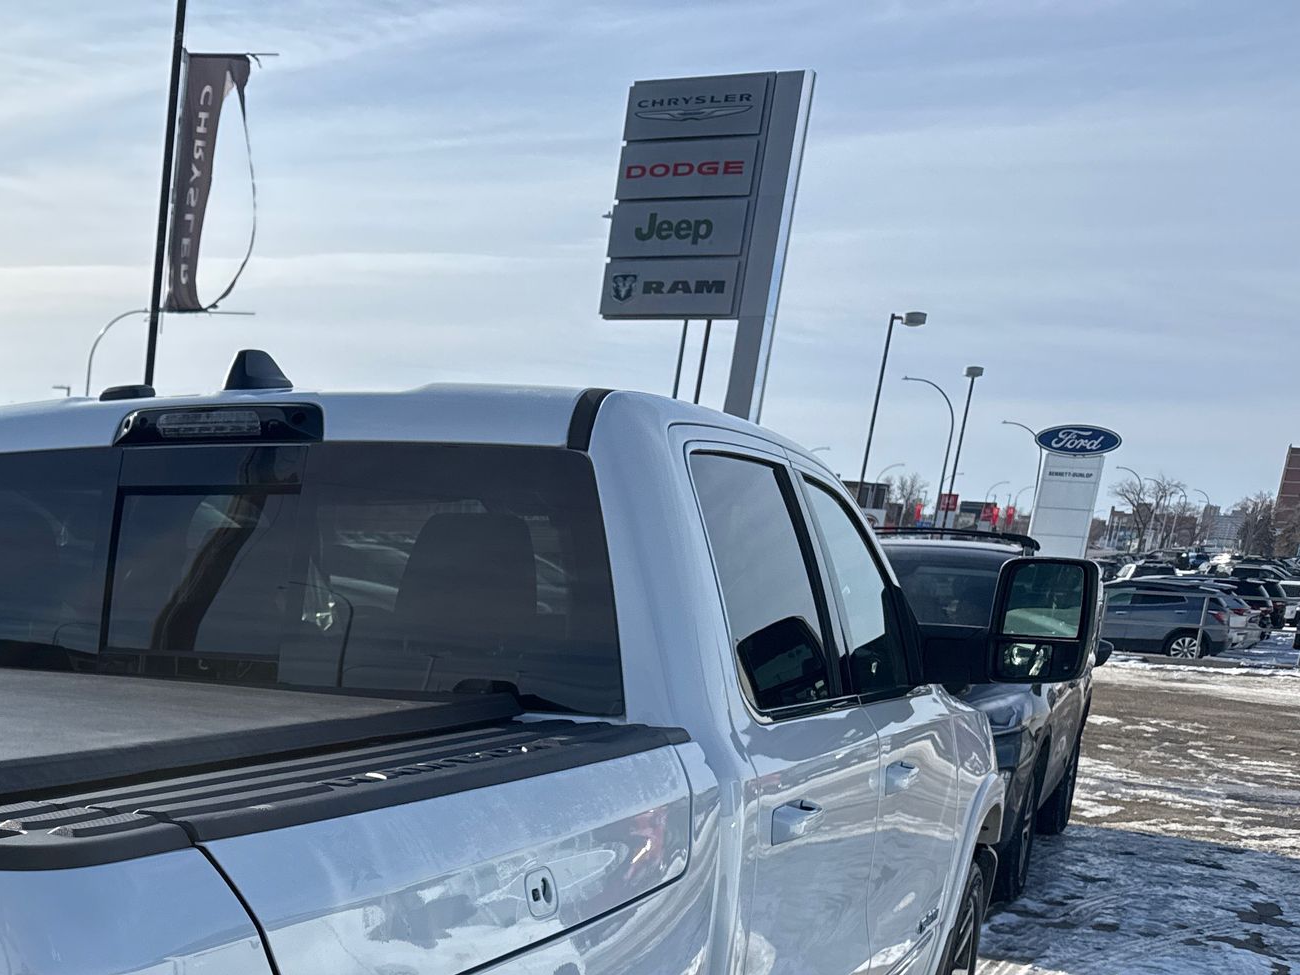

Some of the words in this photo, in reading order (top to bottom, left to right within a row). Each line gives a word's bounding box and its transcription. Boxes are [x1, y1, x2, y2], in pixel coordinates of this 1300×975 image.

[637, 93, 753, 109] CHRYSLER
[625, 160, 745, 179] DODGE
[634, 212, 713, 246] Jeep
[642, 280, 726, 295] RAM
[1051, 428, 1104, 450] Ford
